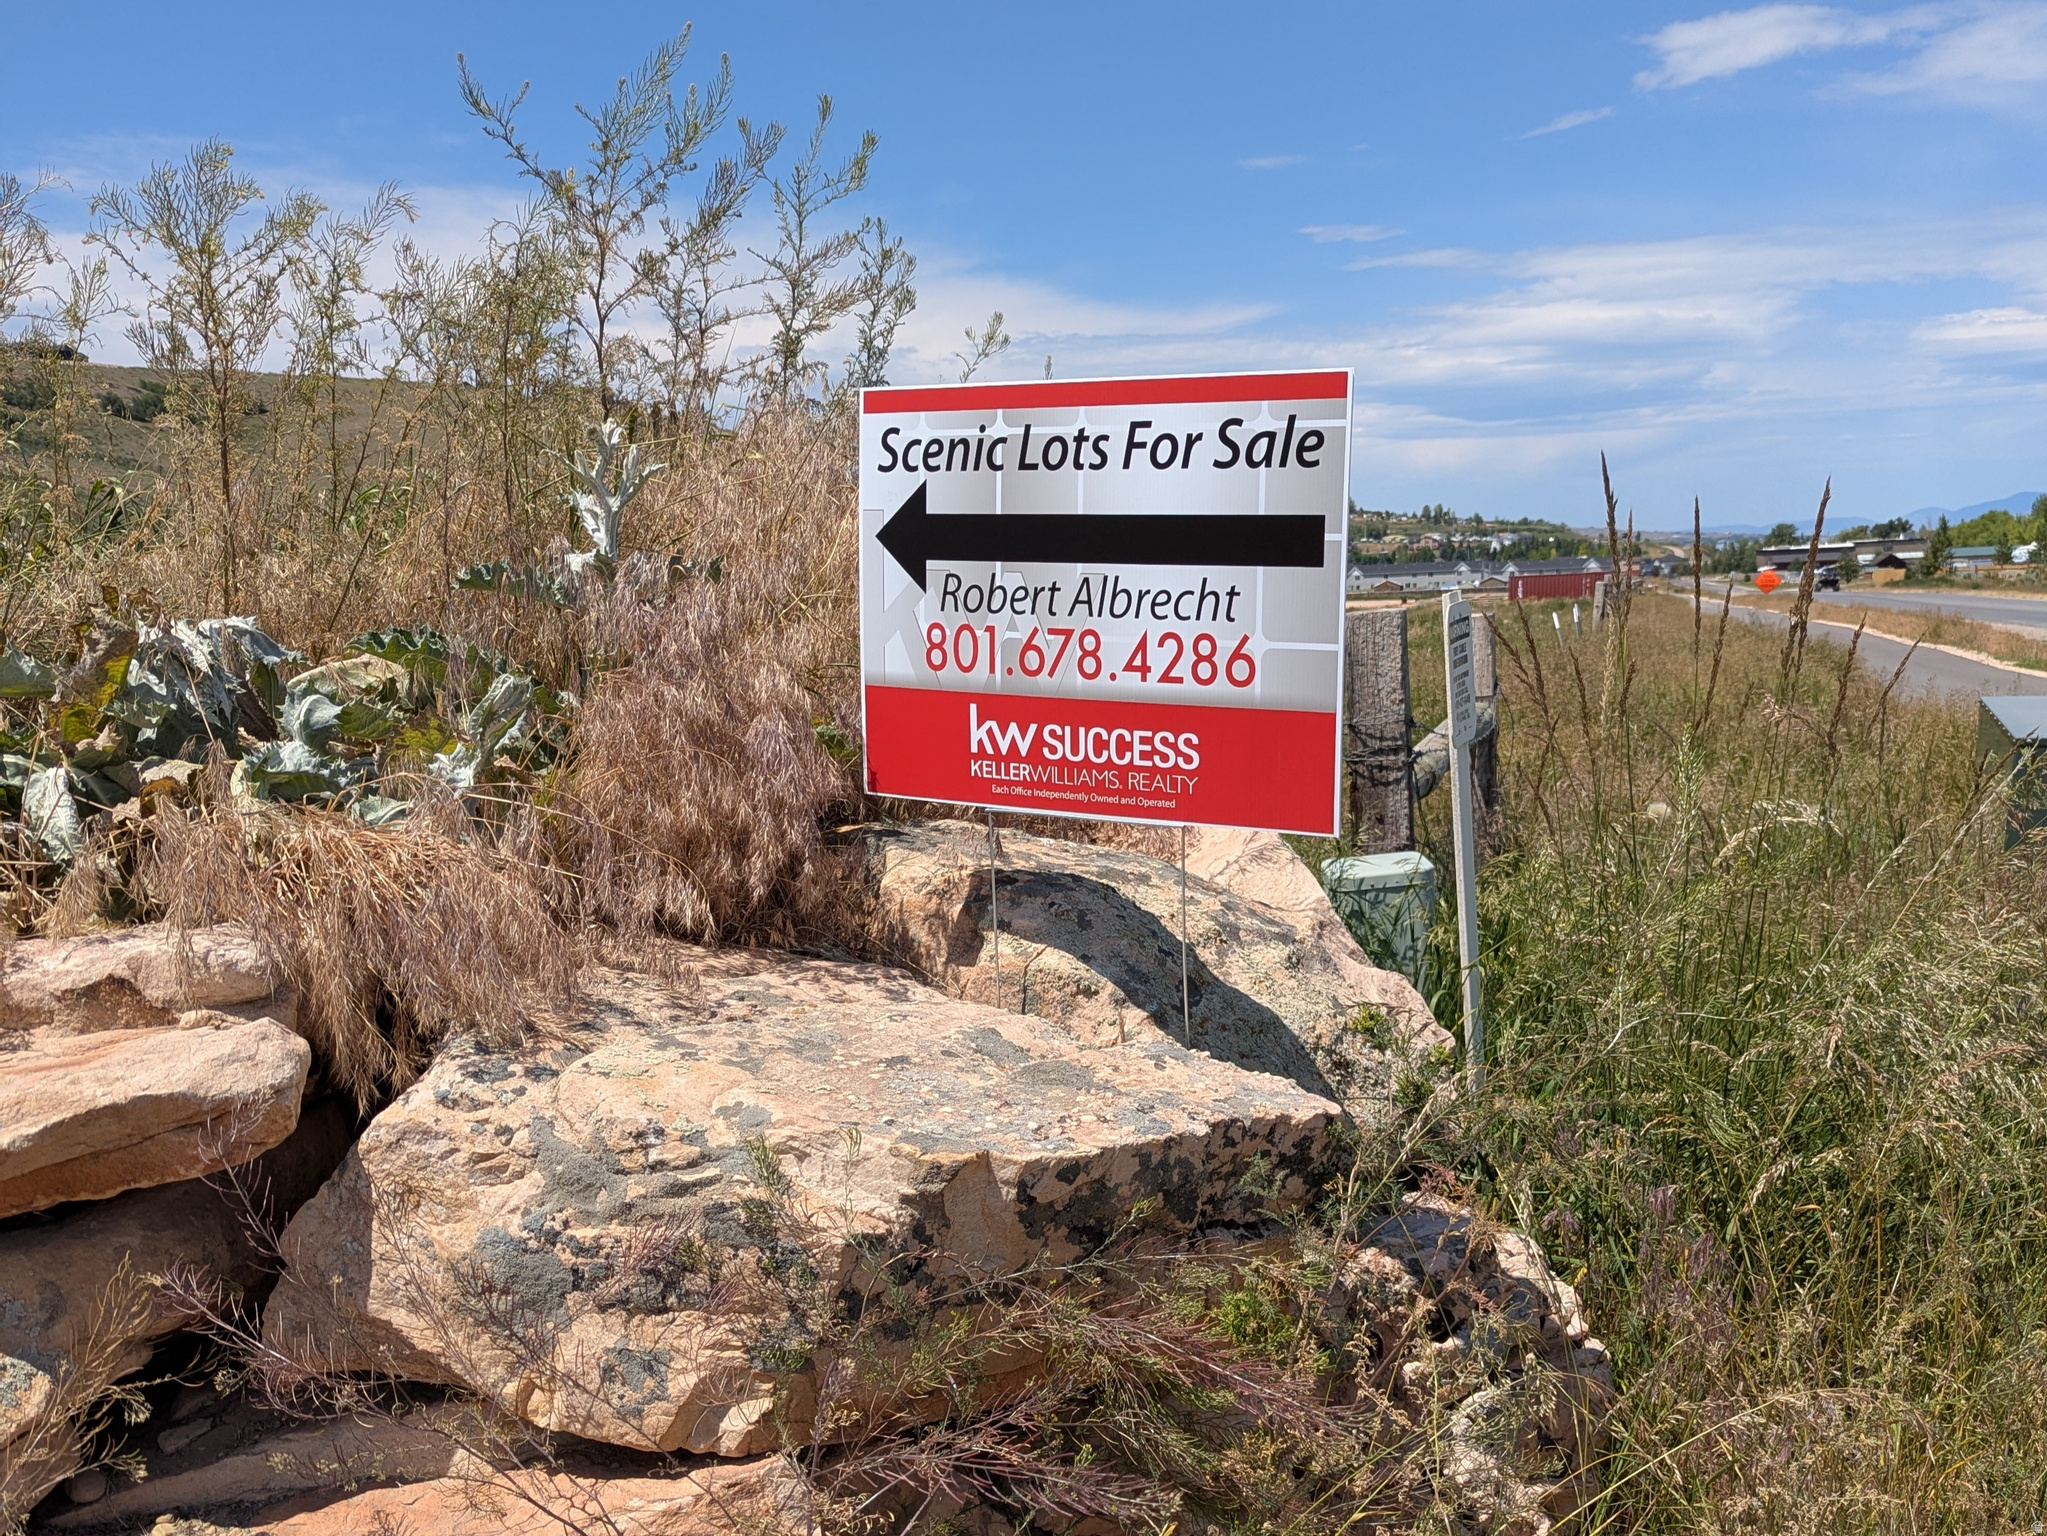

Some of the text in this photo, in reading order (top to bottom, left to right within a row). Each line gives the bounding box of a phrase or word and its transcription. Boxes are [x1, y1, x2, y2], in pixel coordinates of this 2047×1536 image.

[877, 413, 1326, 473] Scenic Lots For Sale
[939, 572, 1241, 623] Robert Albrecht
[925, 621, 1257, 689] 801.678.4286
[1042, 724, 1200, 770] SUCCESS
[991, 784, 1176, 809] Each Office Independently Owned and Operated
[1128, 772, 1199, 795] REALTY
